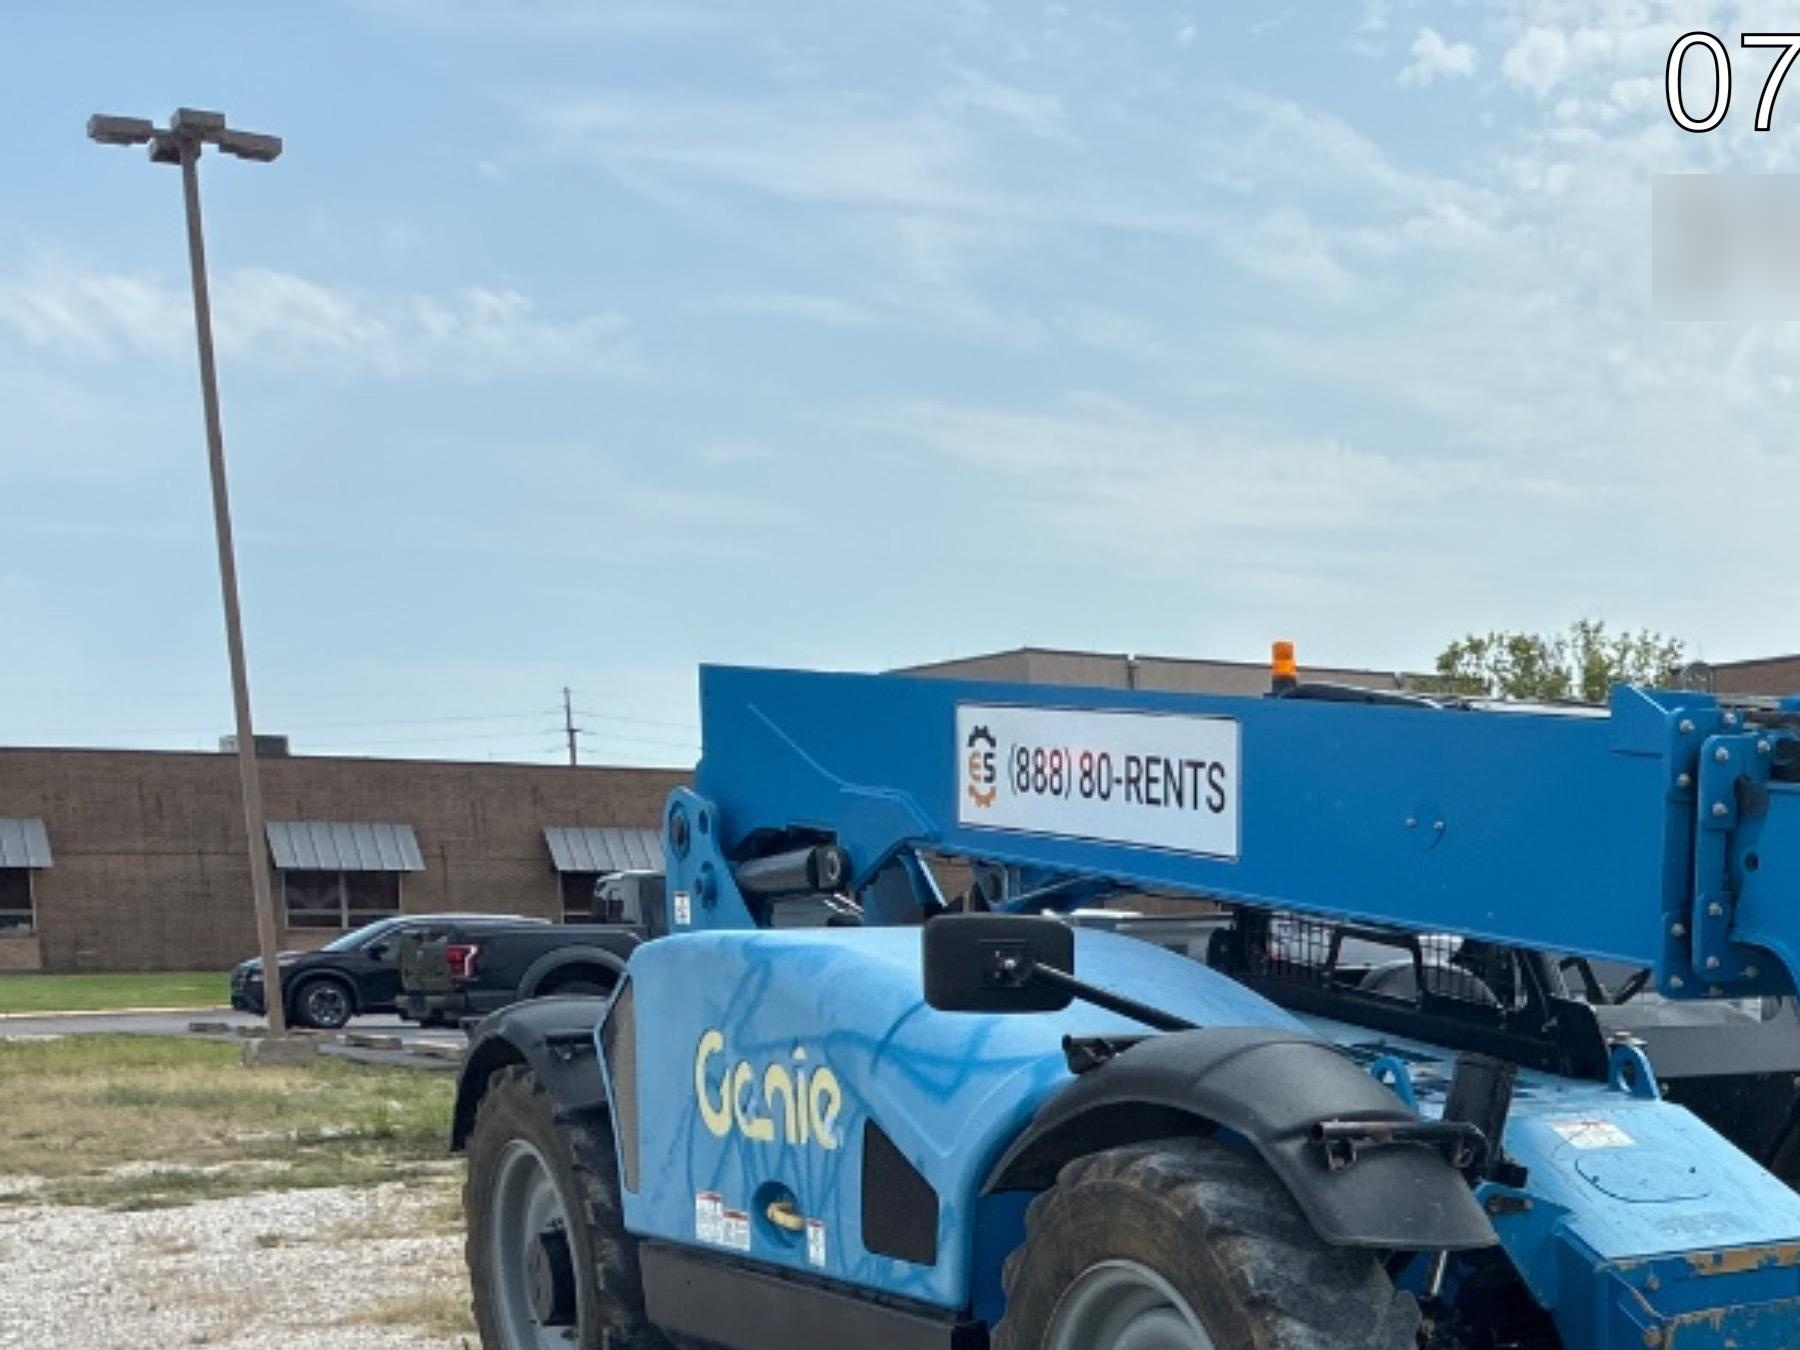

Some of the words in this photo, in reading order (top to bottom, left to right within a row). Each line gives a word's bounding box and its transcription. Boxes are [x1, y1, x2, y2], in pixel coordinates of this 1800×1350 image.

[1008, 743, 1071, 802] (888)
[1078, 750, 1226, 814] 80-RENTS
[694, 1028, 842, 1150] Genie
